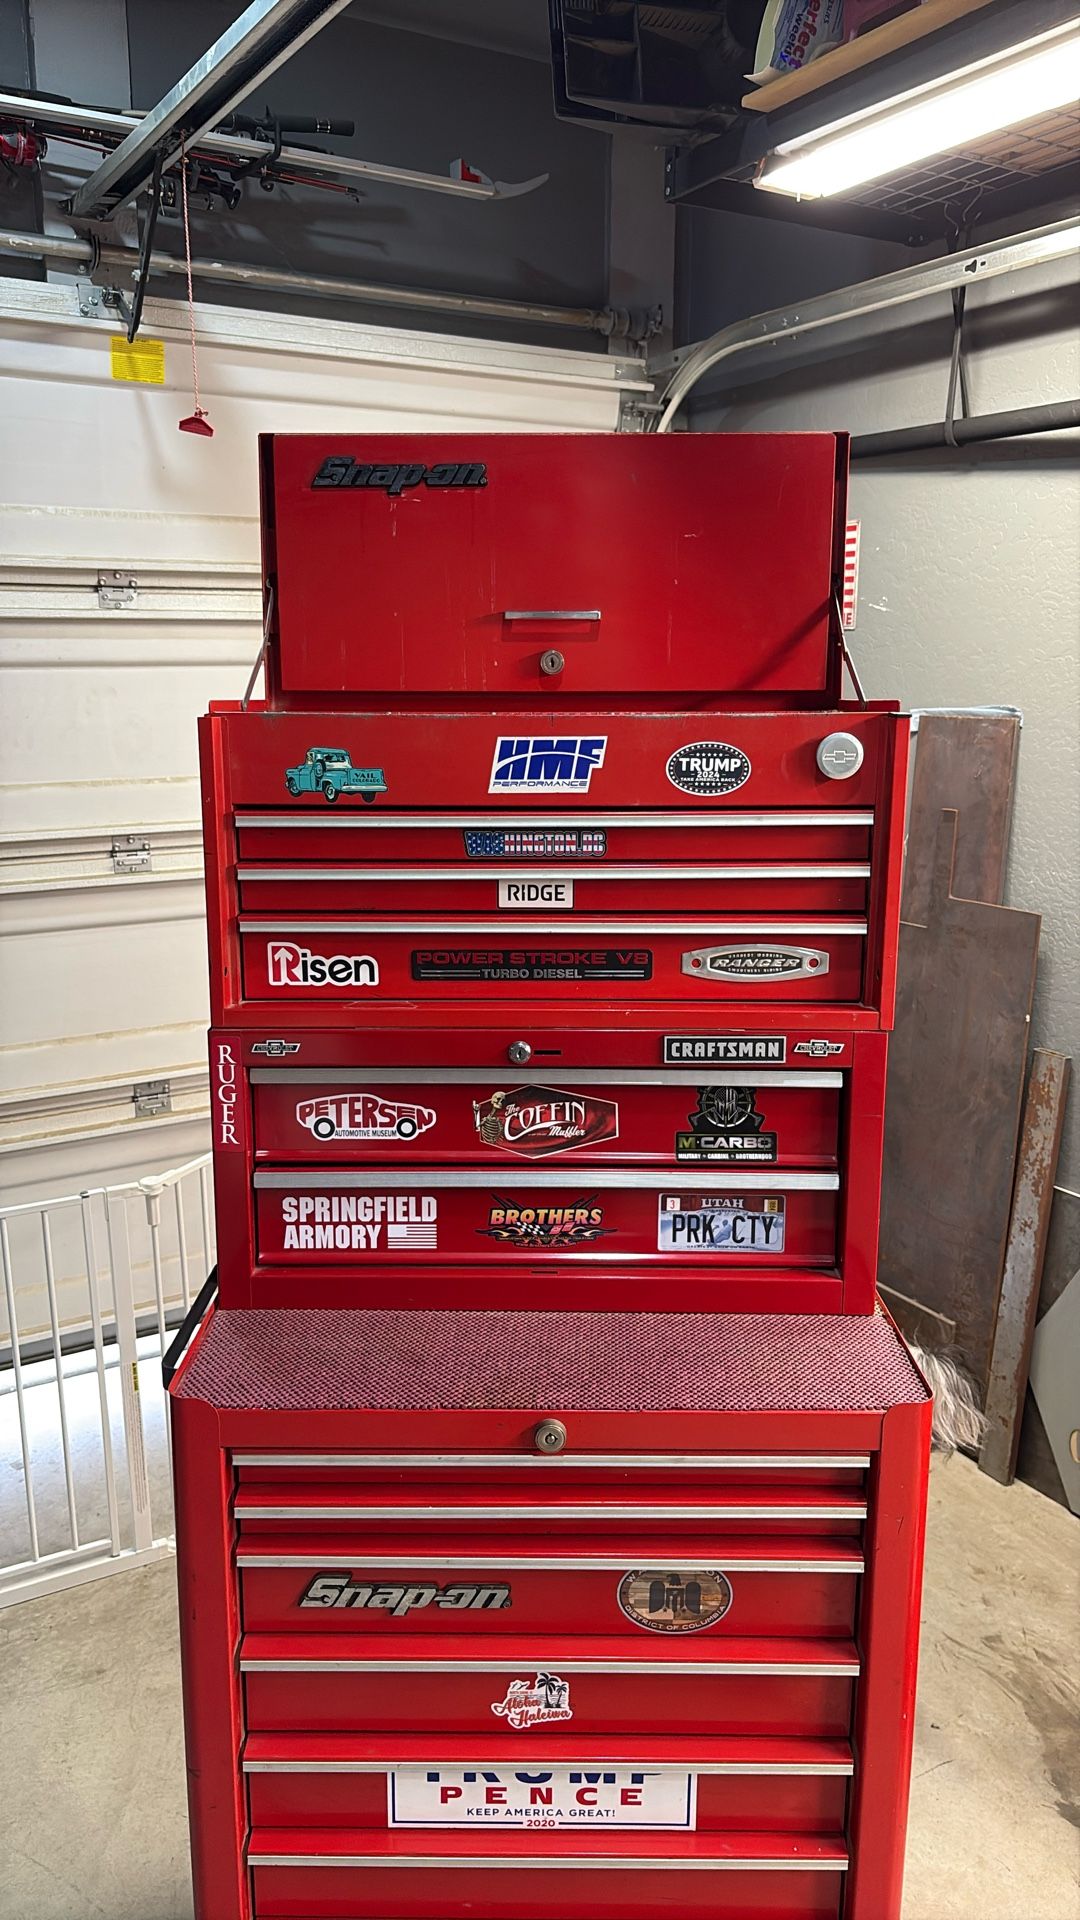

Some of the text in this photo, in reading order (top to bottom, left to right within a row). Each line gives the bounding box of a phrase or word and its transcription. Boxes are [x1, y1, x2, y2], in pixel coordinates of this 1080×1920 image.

[788, 0, 821, 69] erfect
[312, 456, 487, 495] Snap-on
[495, 739, 605, 780] HMF
[679, 757, 741, 772] TRUMP
[507, 884, 565, 901] RIDGE
[270, 945, 376, 983] Risen
[416, 951, 649, 965] POWER STROKE V8
[711, 958, 801, 968] RANGER
[481, 968, 582, 979] TURBO DIESEL
[671, 1041, 780, 1058] CRAFTSMAN
[217, 1045, 240, 1145] RUGER
[299, 1096, 435, 1131] PETERSEN
[505, 1104, 520, 1116] The
[504, 1101, 586, 1141] COFFIN
[335, 1128, 398, 1138] AUTOMOTIVE MUSEUM
[549, 1125, 586, 1138] Muffler
[282, 1196, 438, 1223] SPRINGFIELD
[669, 1199, 676, 1209] 3
[701, 1198, 744, 1208] UTAH
[490, 1208, 603, 1225] BROTHERS
[283, 1224, 382, 1249] ARMORY
[671, 1213, 777, 1244] PRK CTY
[300, 1576, 512, 1616] Snap-on
[624, 1605, 663, 1629] DISTRICT
[682, 1605, 727, 1631] COLUMBIA
[494, 1695, 542, 1714] Aloha
[509, 1708, 571, 1727] Haleiwa
[440, 1786, 643, 1806] PENCE
[466, 1808, 616, 1818] KEEP AMERICA GREAT!
[526, 1819, 556, 1828] 2020
